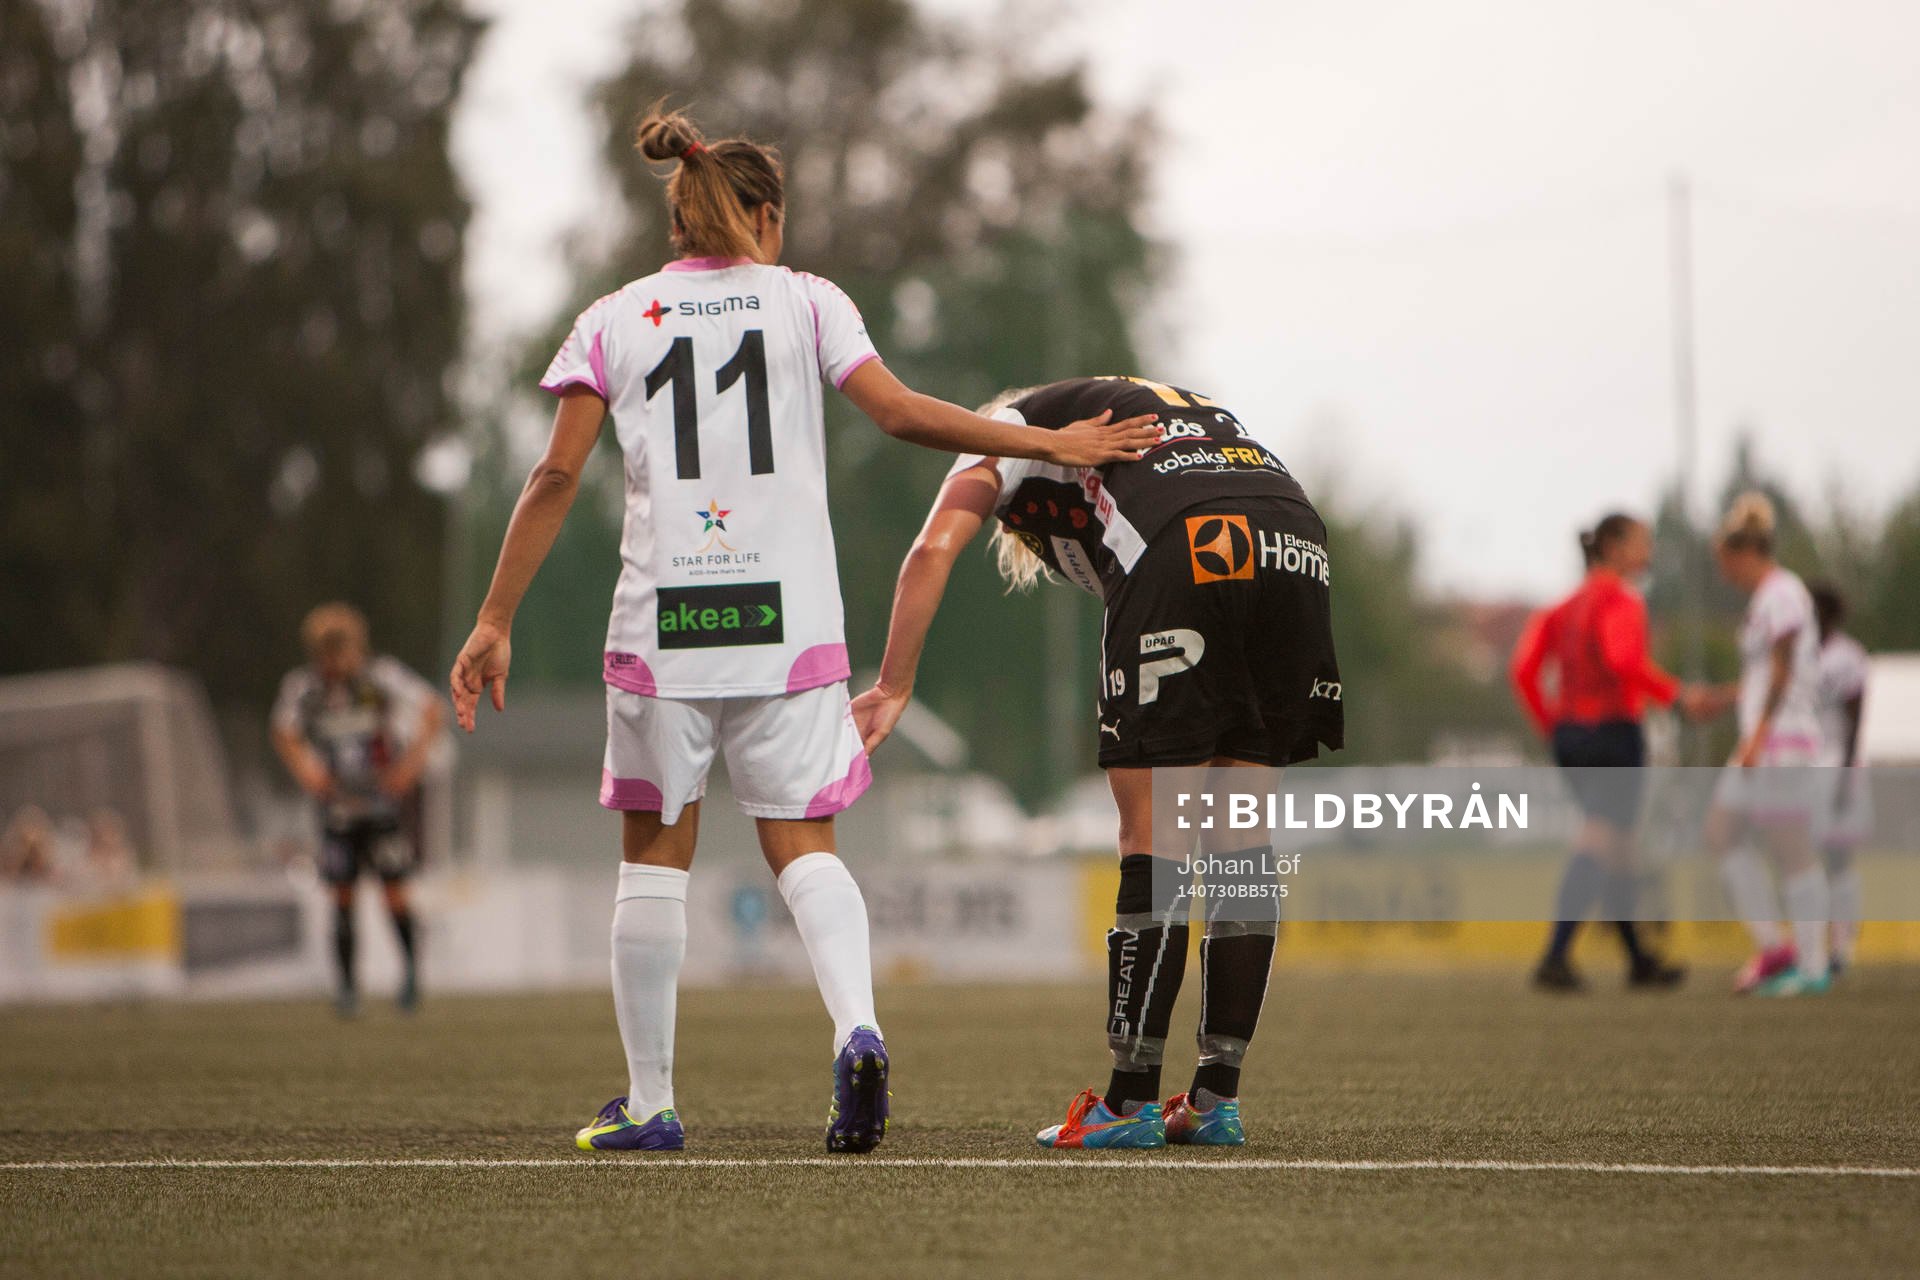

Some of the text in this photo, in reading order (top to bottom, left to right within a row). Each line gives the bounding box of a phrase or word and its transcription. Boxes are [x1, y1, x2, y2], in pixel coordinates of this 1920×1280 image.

[645, 329, 775, 480] 11
[672, 552, 761, 567] STAR FOR LIFE
[1258, 530, 1330, 587] Home
[660, 602, 741, 632] akea
[1109, 668, 1126, 697] 19
